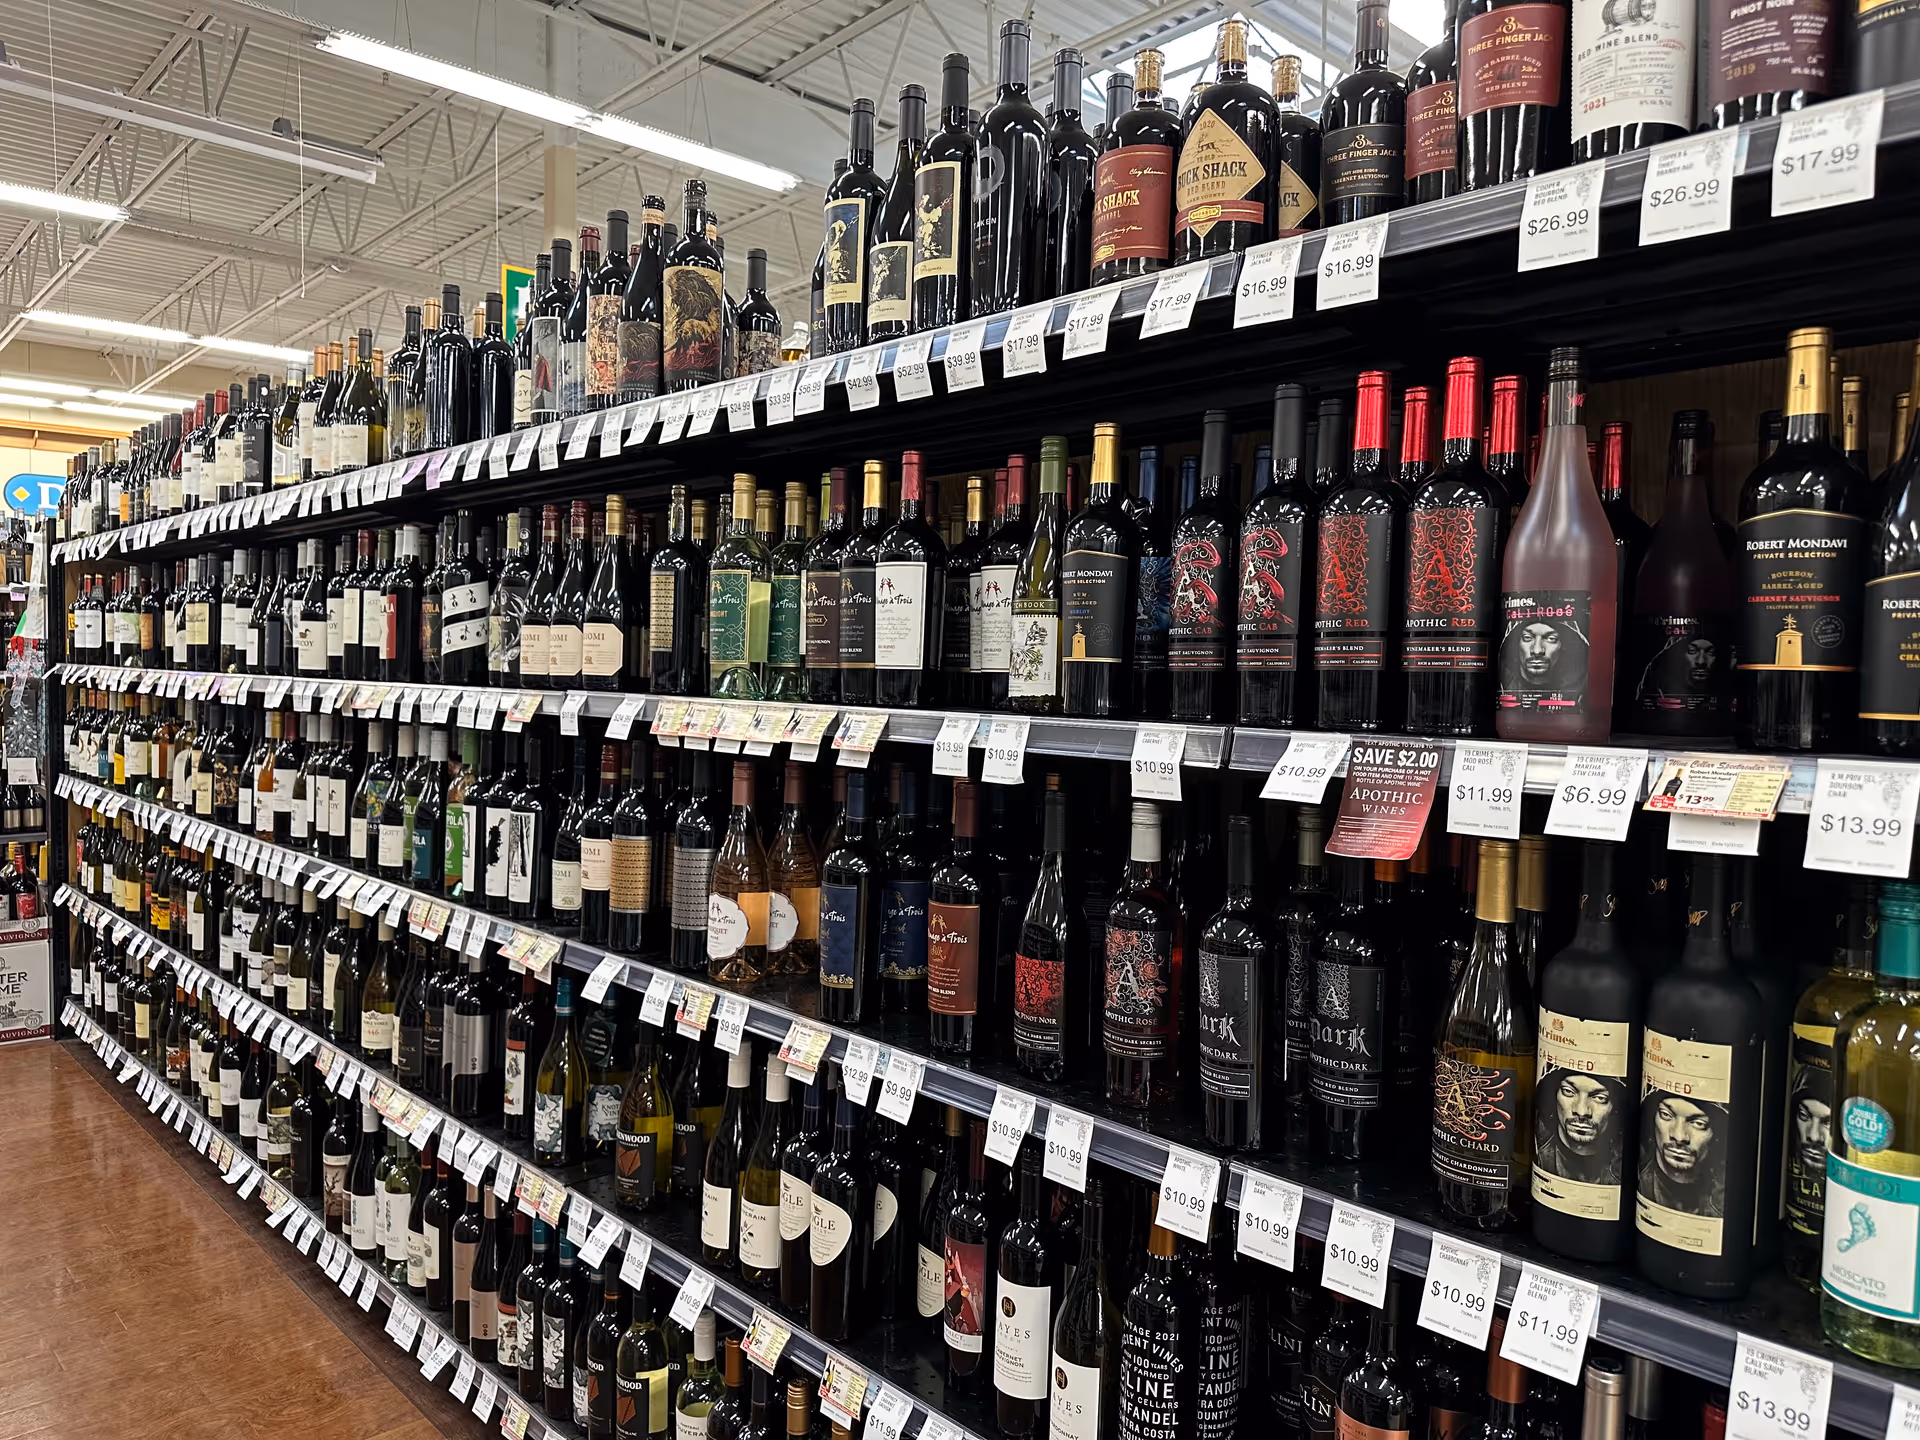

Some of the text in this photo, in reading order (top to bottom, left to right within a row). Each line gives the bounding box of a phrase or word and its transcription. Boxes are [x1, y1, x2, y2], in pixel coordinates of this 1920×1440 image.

[1730, 3, 1762, 19] PINOT
[1467, 33, 1531, 56] THREE FINGER
[1578, 50, 1591, 61] RED
[1595, 38, 1619, 51] WINE
[1624, 33, 1659, 44] BLEND
[1490, 54, 1521, 67] BARREL
[1725, 62, 1756, 80] 2019
[1501, 81, 1528, 91] BLEND
[1583, 96, 1606, 113] 2021
[1411, 112, 1434, 123] THREE
[1199, 120, 1216, 131] 2020
[1326, 148, 1378, 163] THREE FINGER
[1780, 143, 1860, 175] $17.99
[1177, 161, 1248, 191] BUCK SHACK
[1204, 181, 1227, 192] BLEND
[1534, 188, 1565, 199] BOURBON
[1535, 181, 1561, 193] COOPER
[1649, 179, 1720, 207] $26.99
[1103, 189, 1140, 210] SHACK
[973, 216, 997, 229] TAKEN
[1527, 208, 1589, 236] $26.99
[1324, 254, 1374, 278] $16.99
[1242, 275, 1287, 298] $16.99
[1149, 292, 1192, 312] $17.99
[1068, 313, 1104, 333] $17.99
[1006, 333, 1039, 353] $17.99
[946, 351, 976, 369] $39.99
[897, 362, 925, 378] $52.99
[798, 380, 822, 395] $56.99
[847, 375, 873, 390] $42.99
[768, 392, 791, 406] $33.99
[729, 400, 751, 413] $24.99
[1746, 538, 1848, 551] ROBERT MONDAVI
[1752, 551, 1837, 560] PRIVATE SELECTION
[1077, 570, 1113, 578] MONDAVI
[1770, 570, 1814, 580] BOURBON
[723, 594, 740, 604] Trois
[780, 599, 798, 610] Trois
[818, 596, 836, 607] Trois
[854, 592, 872, 605] Trois
[894, 594, 913, 605] Trois
[1747, 595, 1788, 603] CABERNET
[1259, 622, 1278, 631] CAB
[1345, 618, 1369, 628] RED
[1405, 617, 1476, 629] APOTHIC RED
[935, 741, 964, 753] $13.99
[1472, 750, 1495, 758] CRIMES
[987, 748, 1019, 762] $10.99
[1352, 748, 1439, 769] SAVE $2.00
[1585, 757, 1610, 765] CRIMES
[1135, 760, 1174, 775] $10.99
[1277, 765, 1327, 778] $10.99
[1462, 764, 1475, 772] CALI
[1574, 763, 1602, 771] MARTHA
[1668, 758, 1766, 771] Wine Cellar Spectacular
[1456, 784, 1513, 803] $11.99
[1562, 785, 1627, 806] $6.99
[1361, 803, 1406, 816] WINES
[1820, 813, 1902, 837] $13.99
[829, 911, 846, 923] Trois
[904, 905, 924, 917] Trois
[947, 931, 968, 944] Trois
[939, 988, 956, 996] BLEND
[645, 994, 665, 1009] $24.99
[1020, 1013, 1057, 1026] PINOT NOIR
[1104, 1009, 1135, 1025] APOTHIC
[0, 1028, 45, 1040] AUVIGNON
[366, 1027, 381, 1036] 446
[719, 1018, 741, 1036] $9.99
[1542, 1026, 1578, 1047] Crimes.
[1214, 1050, 1239, 1061] DARK
[1340, 1060, 1368, 1071] DARK
[1568, 1057, 1596, 1072] RED
[843, 1065, 868, 1083] $12.99
[1212, 1073, 1230, 1081] BLEND
[885, 1081, 912, 1102] $9.99
[1337, 1083, 1359, 1093] BLEND
[1665, 1080, 1693, 1095] RED
[1847, 1112, 1884, 1134] GOLD!
[991, 1120, 1022, 1142] $10.99
[1459, 1138, 1500, 1153] CHARD
[1048, 1141, 1082, 1166] $10.99
[1173, 1156, 1192, 1167] APOTHIC
[1450, 1158, 1498, 1174] CHARDONNAY
[1253, 1187, 1267, 1197] DARK
[1254, 1181, 1274, 1192] APOTHIC
[1164, 1186, 1206, 1214] $10.99
[1337, 1216, 1356, 1228] CRUSH
[1339, 1209, 1361, 1222] APOTHIC
[1245, 1212, 1290, 1240] $10.99
[589, 1234, 607, 1252] $10.99
[1439, 1244, 1459, 1256] APOTHIC
[626, 1251, 644, 1271] $10.99
[1329, 1243, 1380, 1273] $10.99
[1438, 1251, 1470, 1268] CHARDONNAY
[1539, 1276, 1564, 1291] CRIMES
[1831, 1263, 1886, 1292] MOSCATO
[1529, 1281, 1543, 1292] CALI
[679, 1290, 701, 1310] $10.99
[1430, 1280, 1486, 1313] $10.99
[1526, 1290, 1548, 1302] BLEND
[1517, 1311, 1579, 1346] $11.99
[1155, 1332, 1181, 1342] 2021
[1205, 1334, 1223, 1346] 100
[1205, 1342, 1237, 1352] FARMED
[1133, 1353, 1168, 1371] 100 YEARS
[1152, 1341, 1185, 1374] VINES
[1133, 1366, 1170, 1382] FARMED
[1120, 1363, 1175, 1400] CLINE
[1137, 1396, 1179, 1410] CELLARS
[1737, 1390, 1812, 1432] $13.99
[869, 1414, 897, 1440] $11.99
[1143, 1427, 1176, 1440] COSTA
